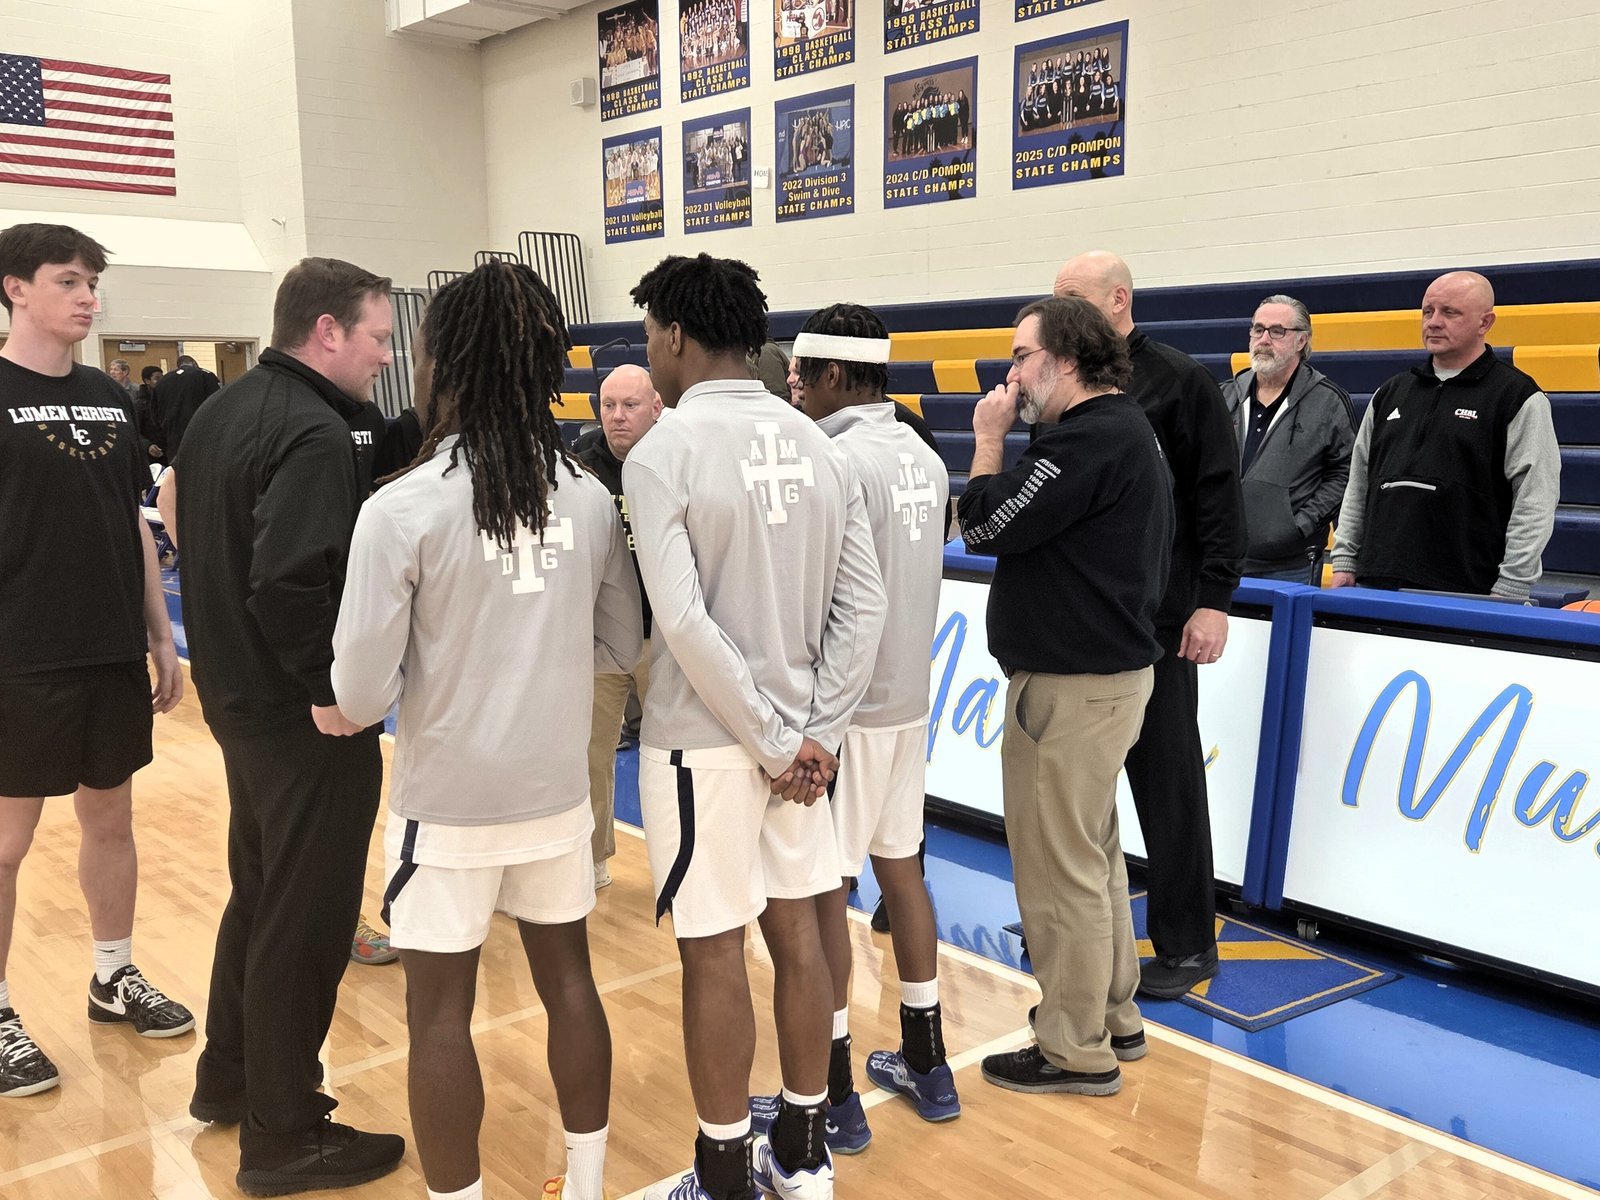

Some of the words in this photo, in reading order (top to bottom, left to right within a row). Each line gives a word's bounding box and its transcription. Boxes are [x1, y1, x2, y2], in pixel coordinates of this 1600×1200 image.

[887, 14, 915, 30] 1998
[920, 0, 976, 20] BASKETBALL
[1018, 0, 1057, 18] STATE
[905, 16, 942, 35] CLASS
[948, 14, 956, 24] A
[805, 30, 852, 50] BASKETBALL
[887, 33, 920, 50] STATE
[925, 19, 975, 41] CHAMPS
[776, 62, 804, 77] STATE
[809, 51, 851, 69] CHAMPS
[792, 48, 824, 64] CLASS
[828, 45, 834, 54] A
[707, 58, 747, 76] BASKETBALL
[623, 81, 659, 97] BASKETBALL
[682, 87, 707, 100] STATE
[710, 76, 747, 92] CHAMPS
[696, 74, 724, 88] CLASS
[727, 71, 733, 80] A
[602, 107, 624, 119] STATE
[626, 98, 658, 113] CHAMPS
[614, 96, 638, 108] CLASS
[641, 92, 646, 102] A
[1015, 149, 1043, 163] 2025
[1047, 145, 1067, 158] C/D
[1070, 136, 1121, 154] POMPON
[886, 172, 909, 184] 2024
[912, 169, 928, 180] C/D
[932, 162, 974, 178] POMPON
[1016, 164, 1054, 179] STATE
[1061, 154, 1120, 172] CHAMPS
[782, 179, 802, 191] 2022
[805, 174, 838, 188] Division
[841, 172, 846, 182] 3
[886, 186, 919, 199] STATE
[924, 178, 974, 194] CHAMPS
[788, 190, 810, 202] Swim
[813, 188, 819, 198] &
[822, 186, 840, 197] Dive
[685, 204, 701, 214] 2022
[715, 197, 750, 210] Volleyball
[778, 203, 806, 215] STATE
[810, 196, 852, 210] CHAMPS
[605, 216, 620, 225] 2021
[632, 209, 663, 221] Volleyball
[686, 216, 710, 227] STATE
[714, 210, 750, 223] CHAMPS
[606, 226, 628, 237] STATE
[630, 223, 663, 234] CHAMPS
[8, 406, 70, 424] LUMEN
[70, 406, 128, 422] CHRISTI
[995, 508, 1012, 523] 2007
[1340, 669, 1600, 860] Mu
